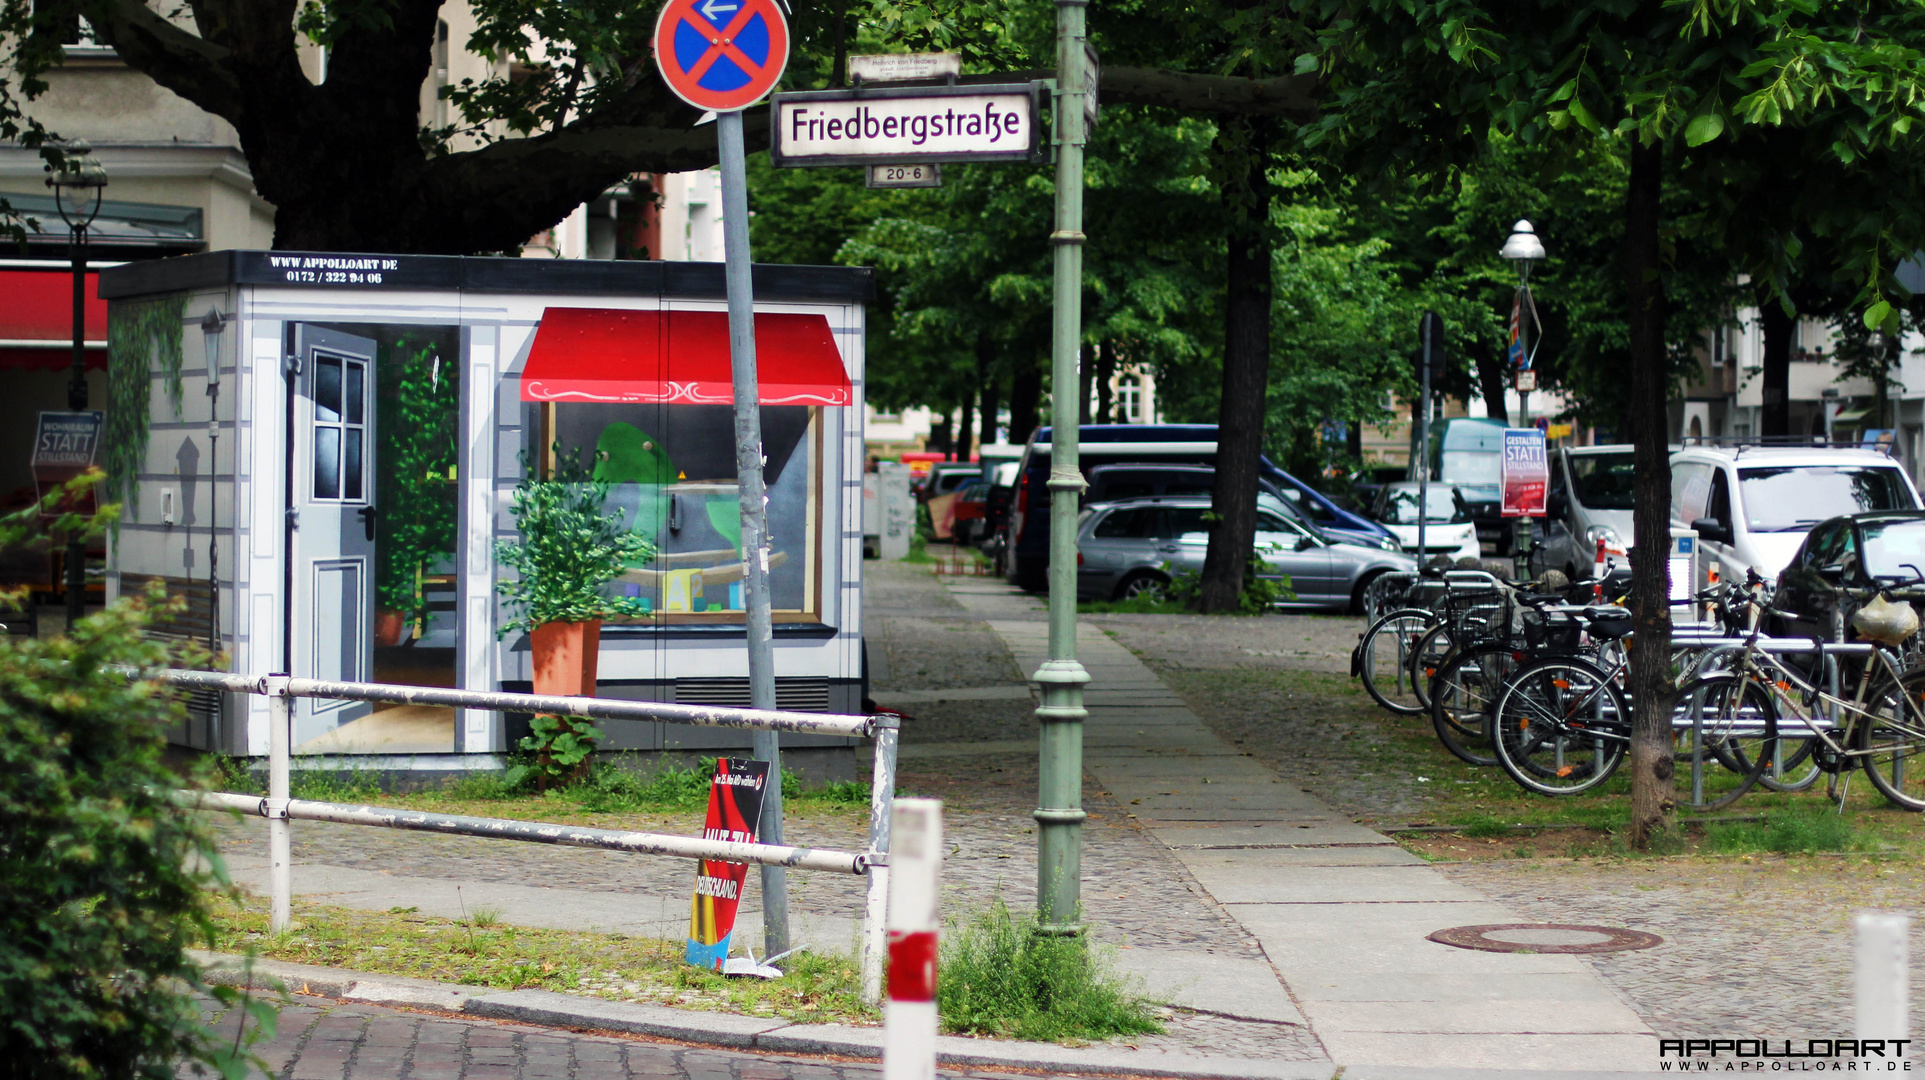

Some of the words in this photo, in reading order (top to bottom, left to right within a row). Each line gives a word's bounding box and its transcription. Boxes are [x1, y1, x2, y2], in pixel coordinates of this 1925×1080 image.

[792, 102, 1020, 145] Friedbergstraße
[270, 256, 302, 268] WWW
[303, 257, 380, 270] APPOLLOART
[382, 259, 398, 270] DE
[286, 270, 315, 282] 0172
[325, 271, 347, 283] 322
[349, 273, 364, 284] 94
[367, 273, 383, 284] 06
[43, 422, 94, 432] WOHNRAUM
[41, 433, 93, 452] STATT
[1506, 436, 1542, 446] GESTALTEN
[38, 452, 88, 463] STILLSTAND
[1506, 446, 1542, 461] STATT
[1507, 461, 1544, 470] STILLSTAND
[695, 875, 737, 900] DEUTSCHLAND.
